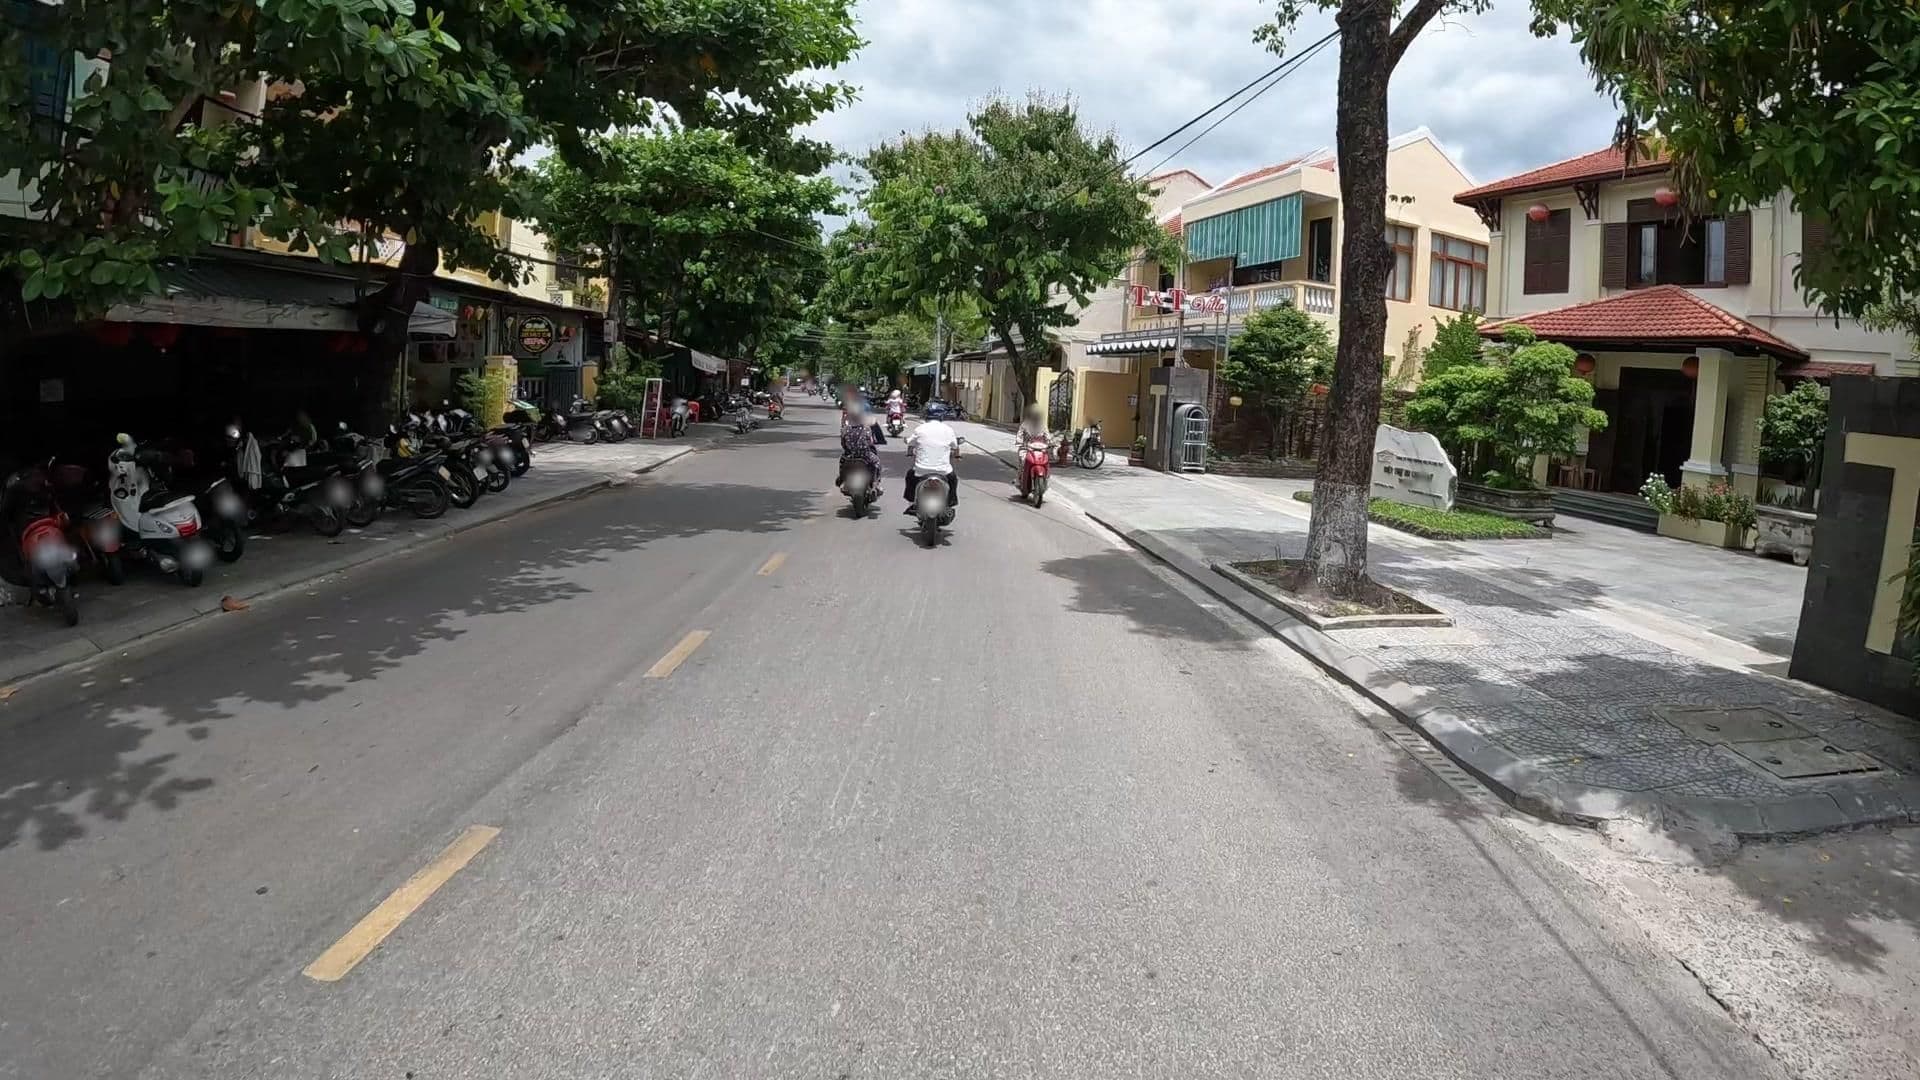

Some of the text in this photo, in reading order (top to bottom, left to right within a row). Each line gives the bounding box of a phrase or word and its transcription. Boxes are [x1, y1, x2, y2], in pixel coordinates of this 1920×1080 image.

[1131, 285, 1150, 308] T
[1167, 288, 1187, 312] T
[1191, 295, 1225, 313] Villa
